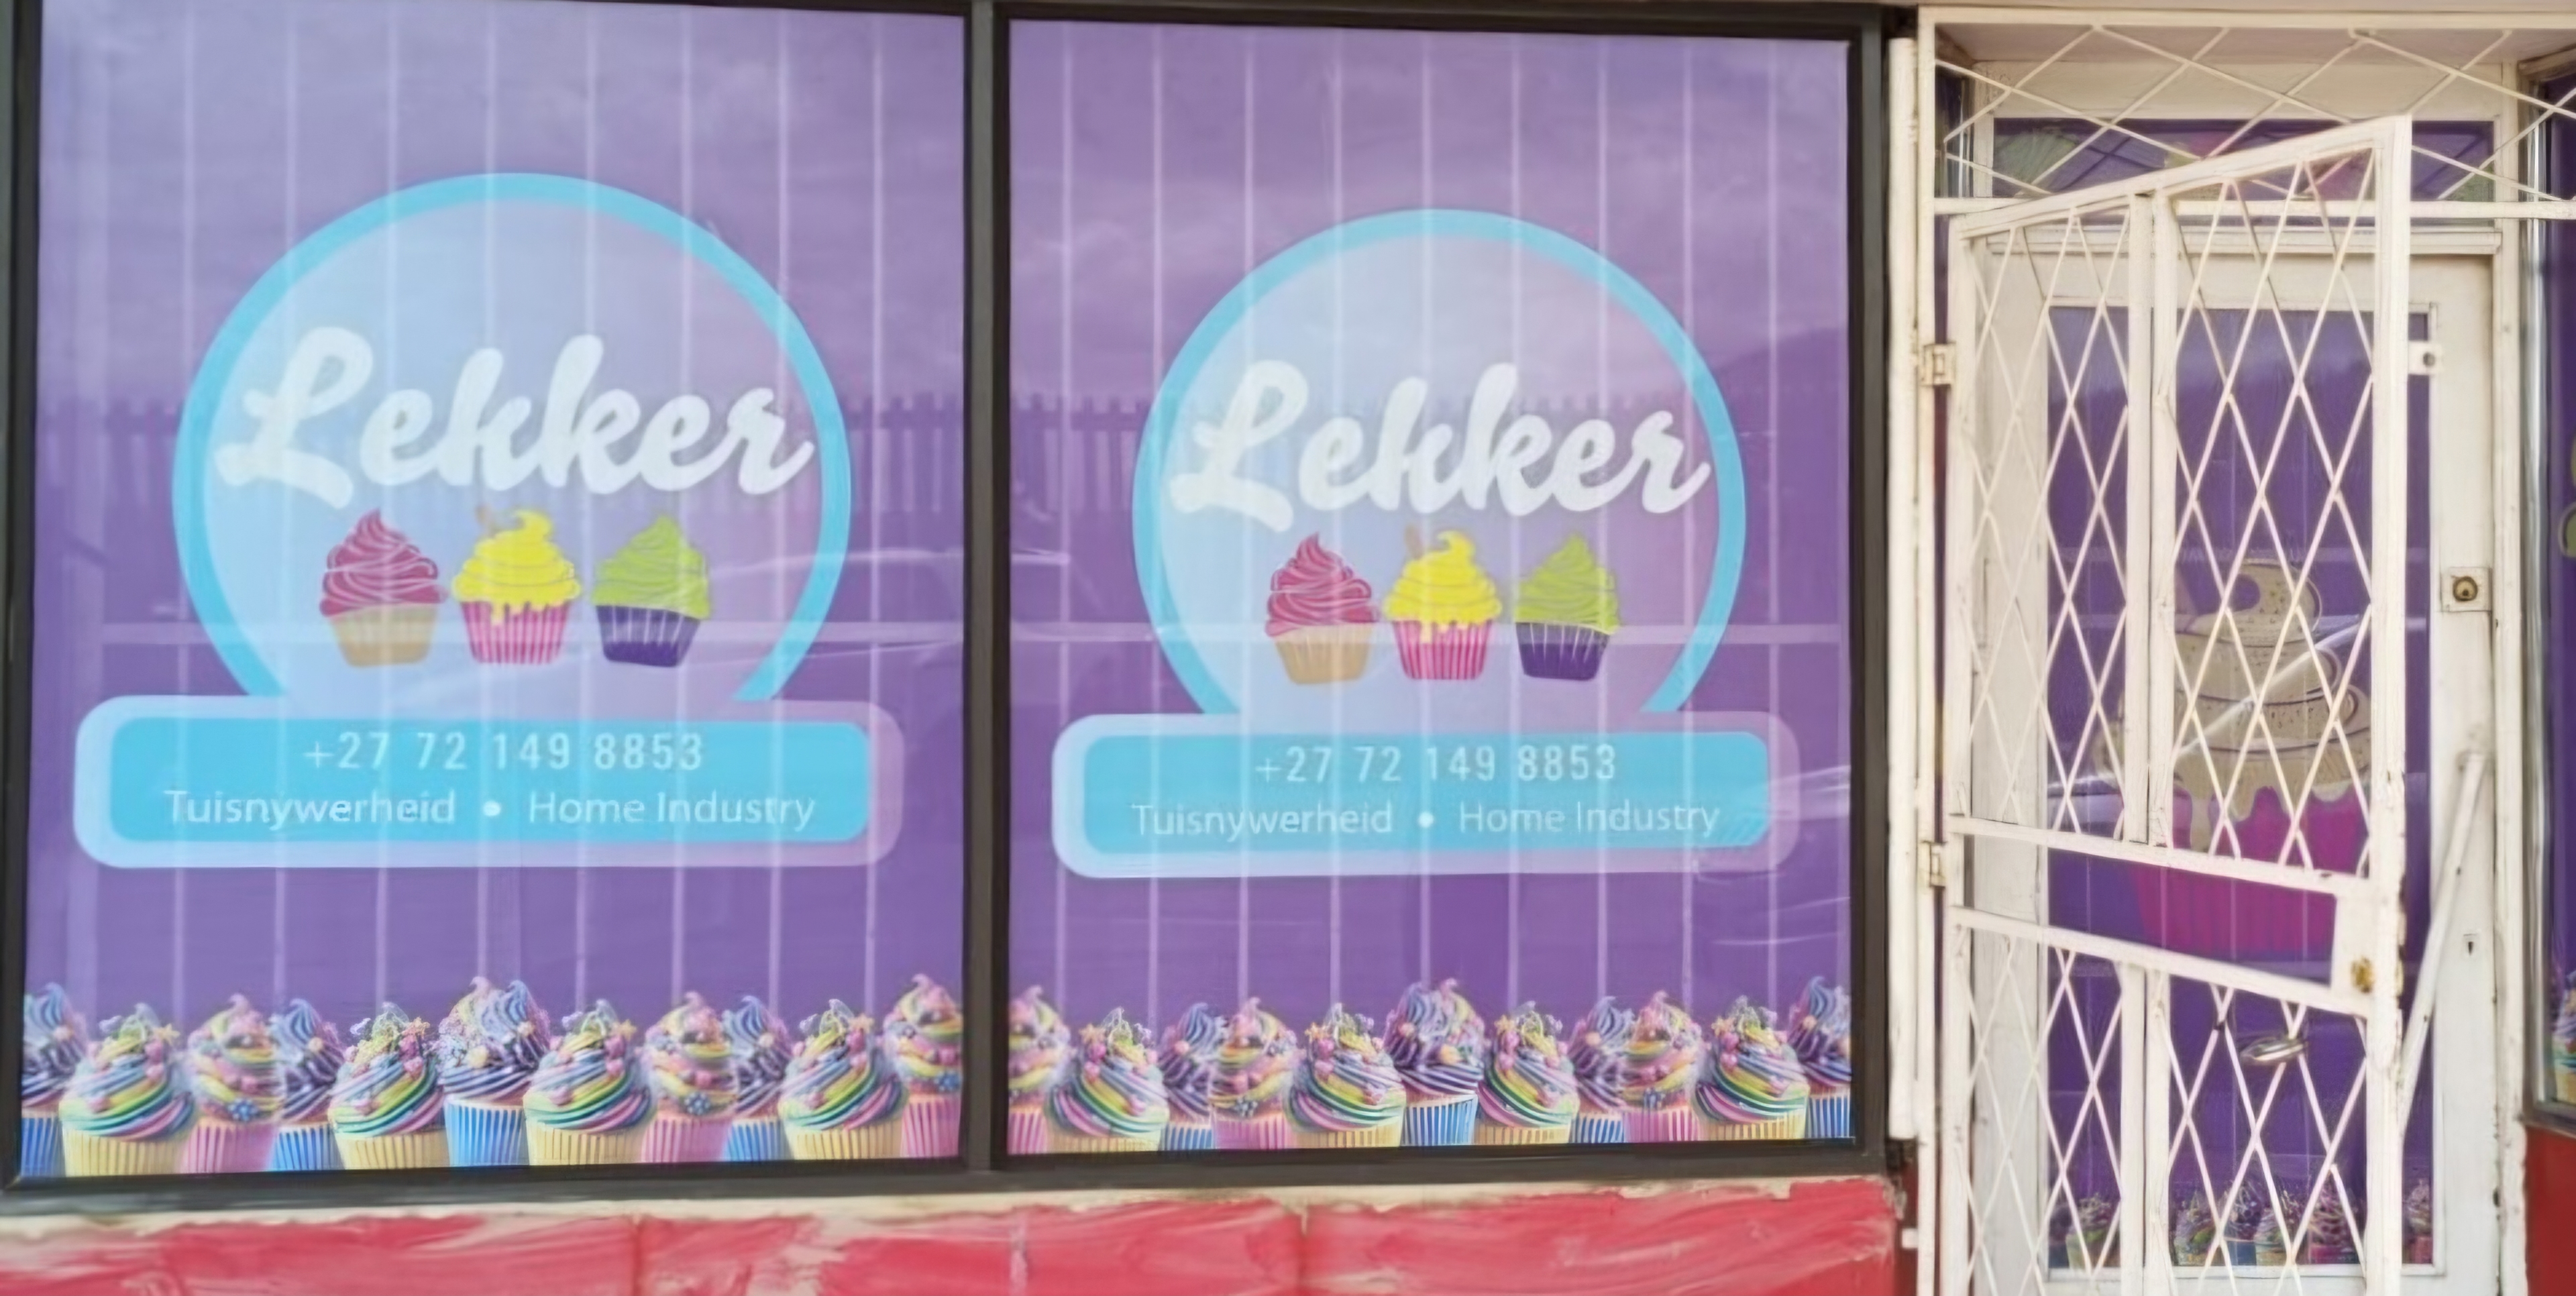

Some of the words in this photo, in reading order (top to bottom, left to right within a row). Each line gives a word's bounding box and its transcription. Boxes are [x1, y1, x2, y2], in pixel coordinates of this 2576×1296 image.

[214, 326, 814, 509] Lekker
[1169, 360, 1711, 532] Lekker
[303, 732, 389, 771] +27
[416, 733, 467, 771] 72
[492, 733, 572, 771] 149
[594, 733, 704, 771] 8853
[1255, 746, 1332, 784] +27
[1356, 746, 1402, 782] 72
[1424, 746, 1496, 782] 149
[1517, 745, 1617, 782] 8853
[164, 790, 456, 829] Tuisnywerheid
[529, 792, 645, 824] Home
[659, 790, 816, 832] Industry
[1132, 803, 1393, 842] Tuisnywerheid
[1458, 803, 1563, 833] Home
[1576, 801, 1719, 838] Industry
